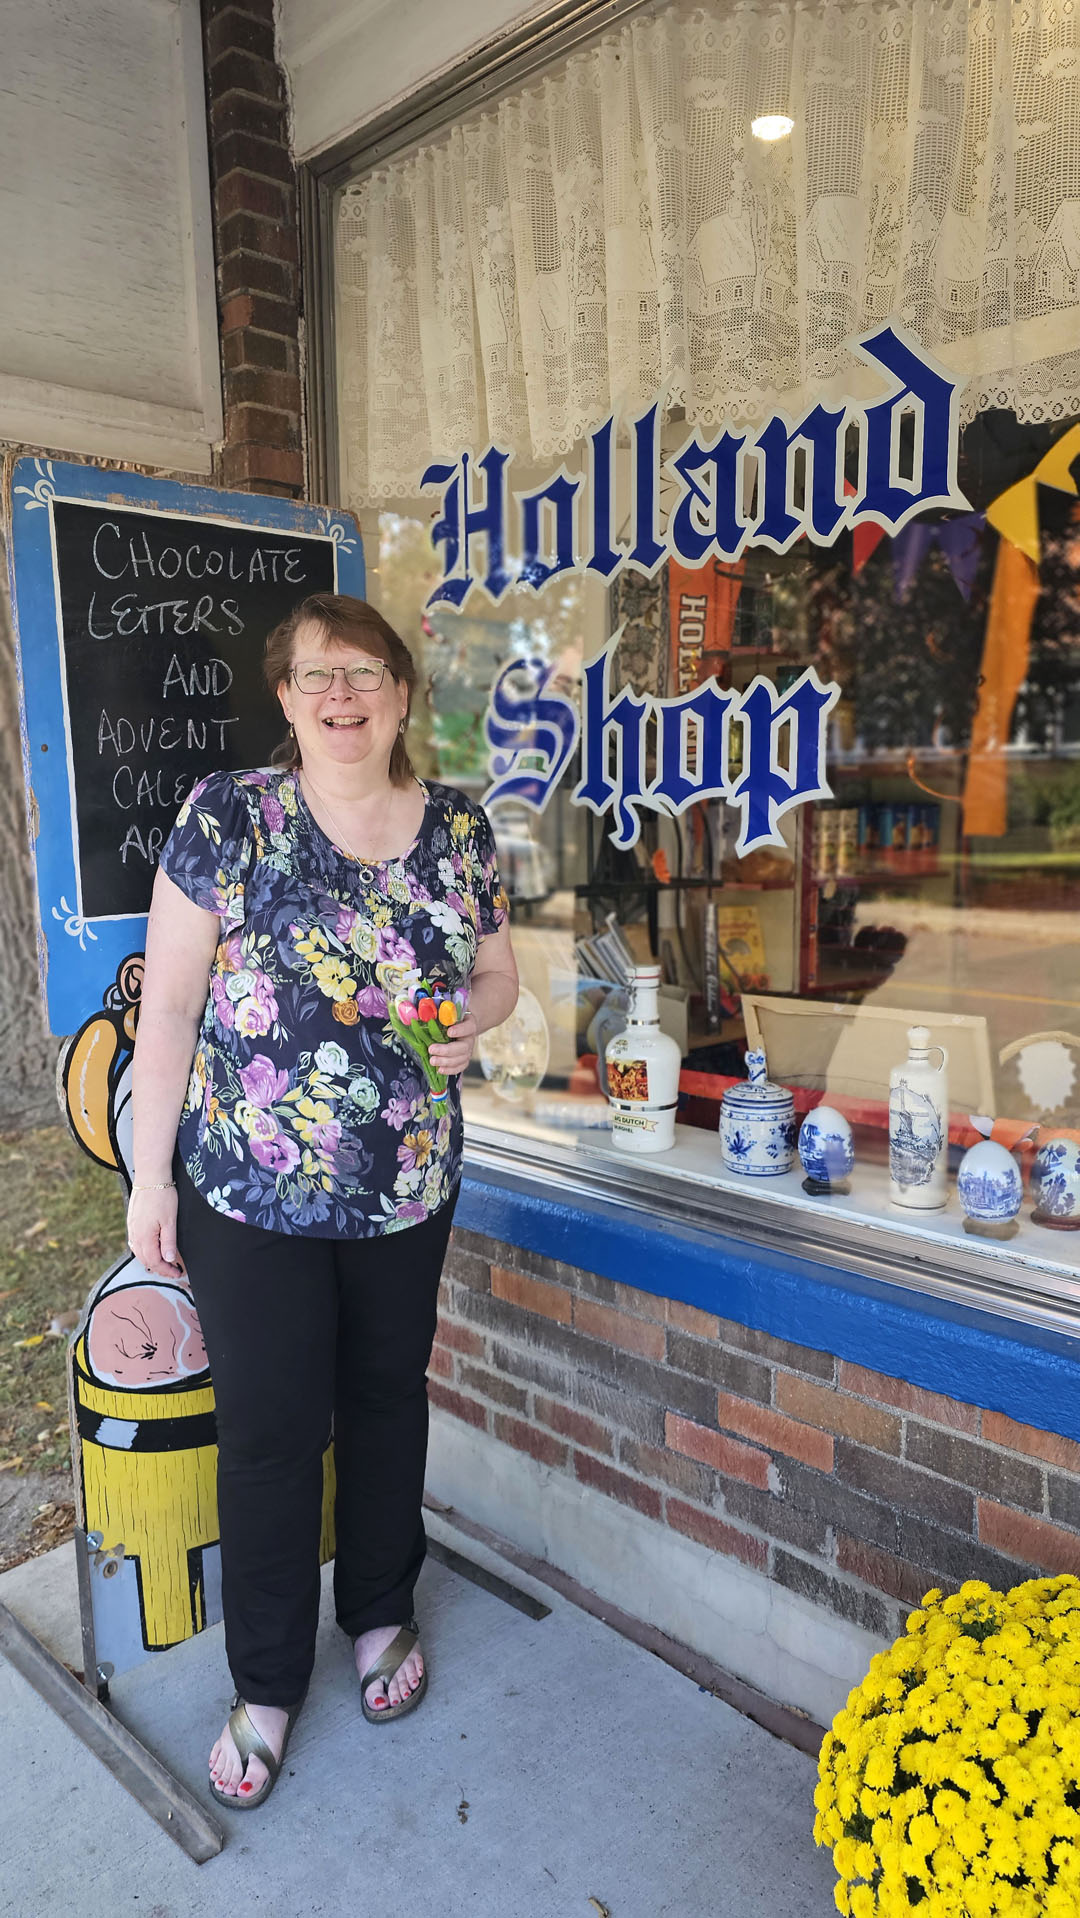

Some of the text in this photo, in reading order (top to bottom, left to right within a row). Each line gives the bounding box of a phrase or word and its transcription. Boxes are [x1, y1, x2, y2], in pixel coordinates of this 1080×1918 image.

[419, 320, 970, 614] Holland
[93, 522, 307, 584] CHOCOLATE
[88, 591, 245, 640] LETTERS
[162, 653, 234, 699] AND
[97, 708, 239, 756] ADVENT
[484, 626, 841, 858] Shop
[112, 765, 198, 809] CALE
[118, 824, 163, 865] AR
[621, 1117, 645, 1126] DUTCH
